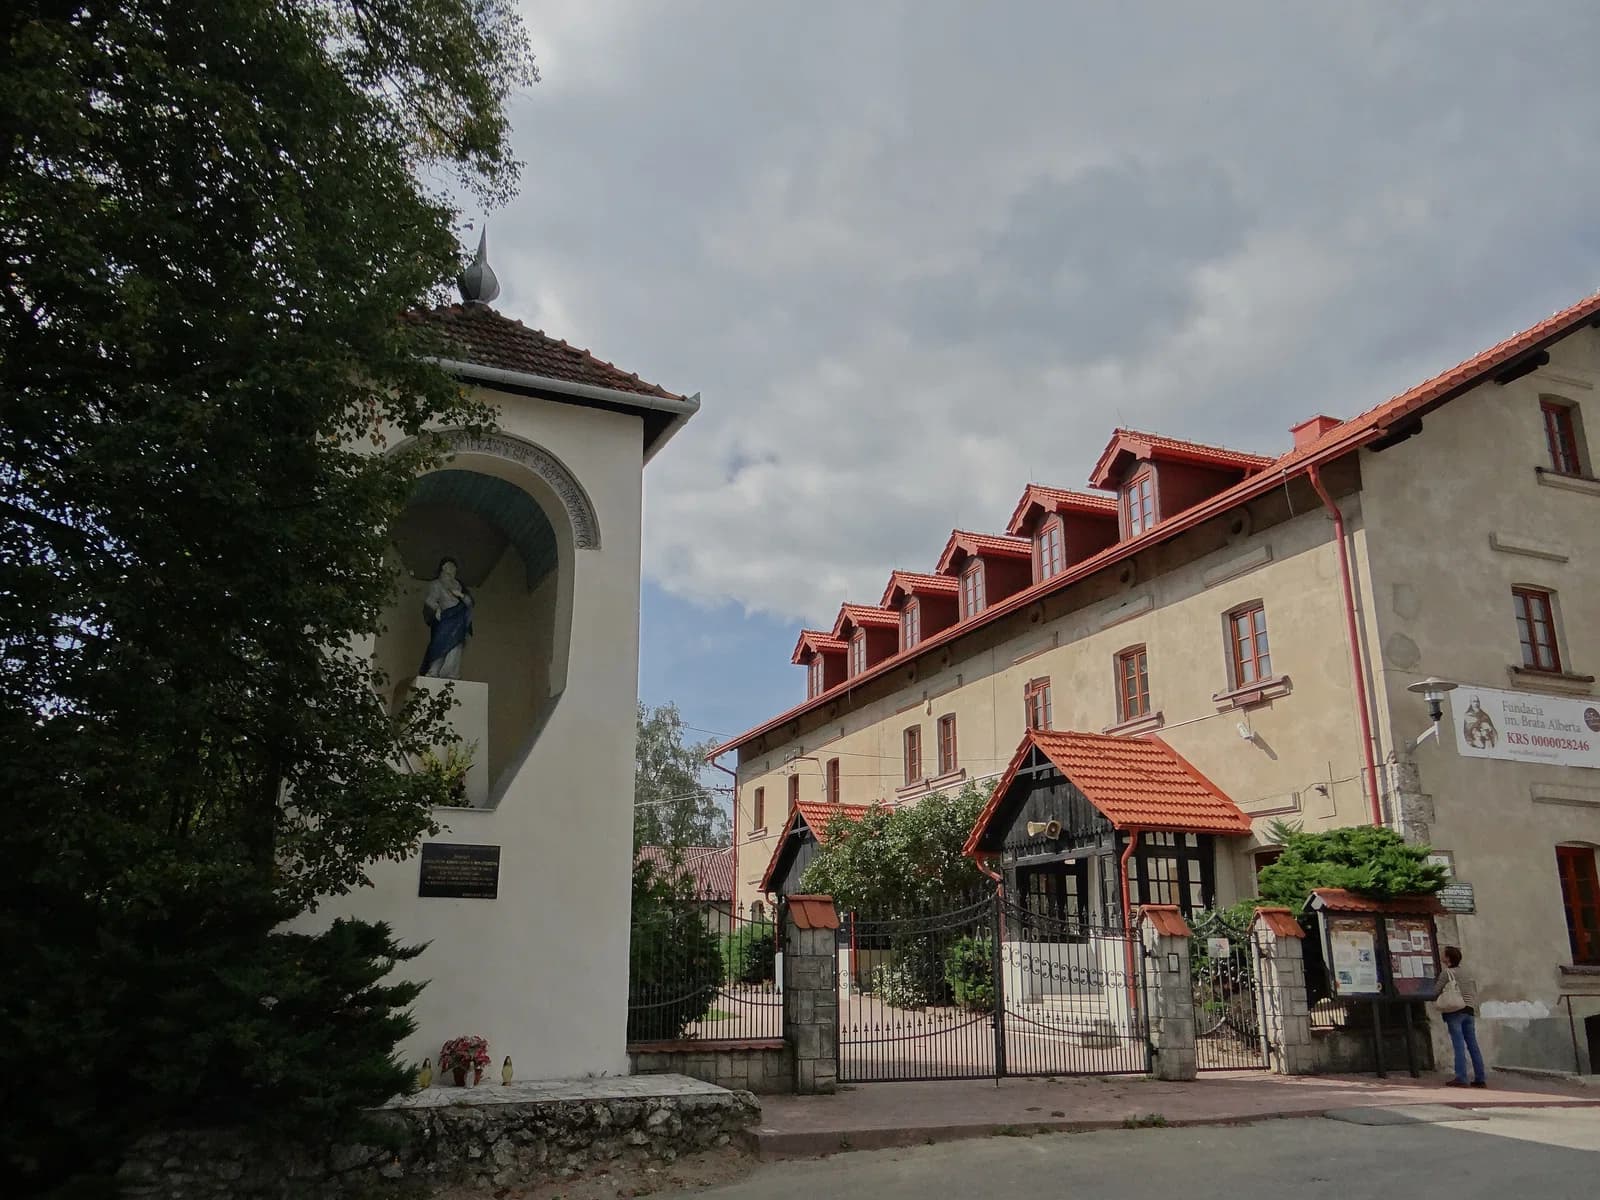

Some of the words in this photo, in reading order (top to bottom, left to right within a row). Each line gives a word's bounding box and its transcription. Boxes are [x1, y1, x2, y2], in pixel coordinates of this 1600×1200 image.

[1502, 700, 1544, 719] Fundacja
[1504, 716, 1520, 726] im.
[1521, 715, 1545, 729] Brata
[1548, 719, 1582, 733] Alberta
[1507, 732, 1529, 745] KRS
[1531, 735, 1590, 751] 0000028246
